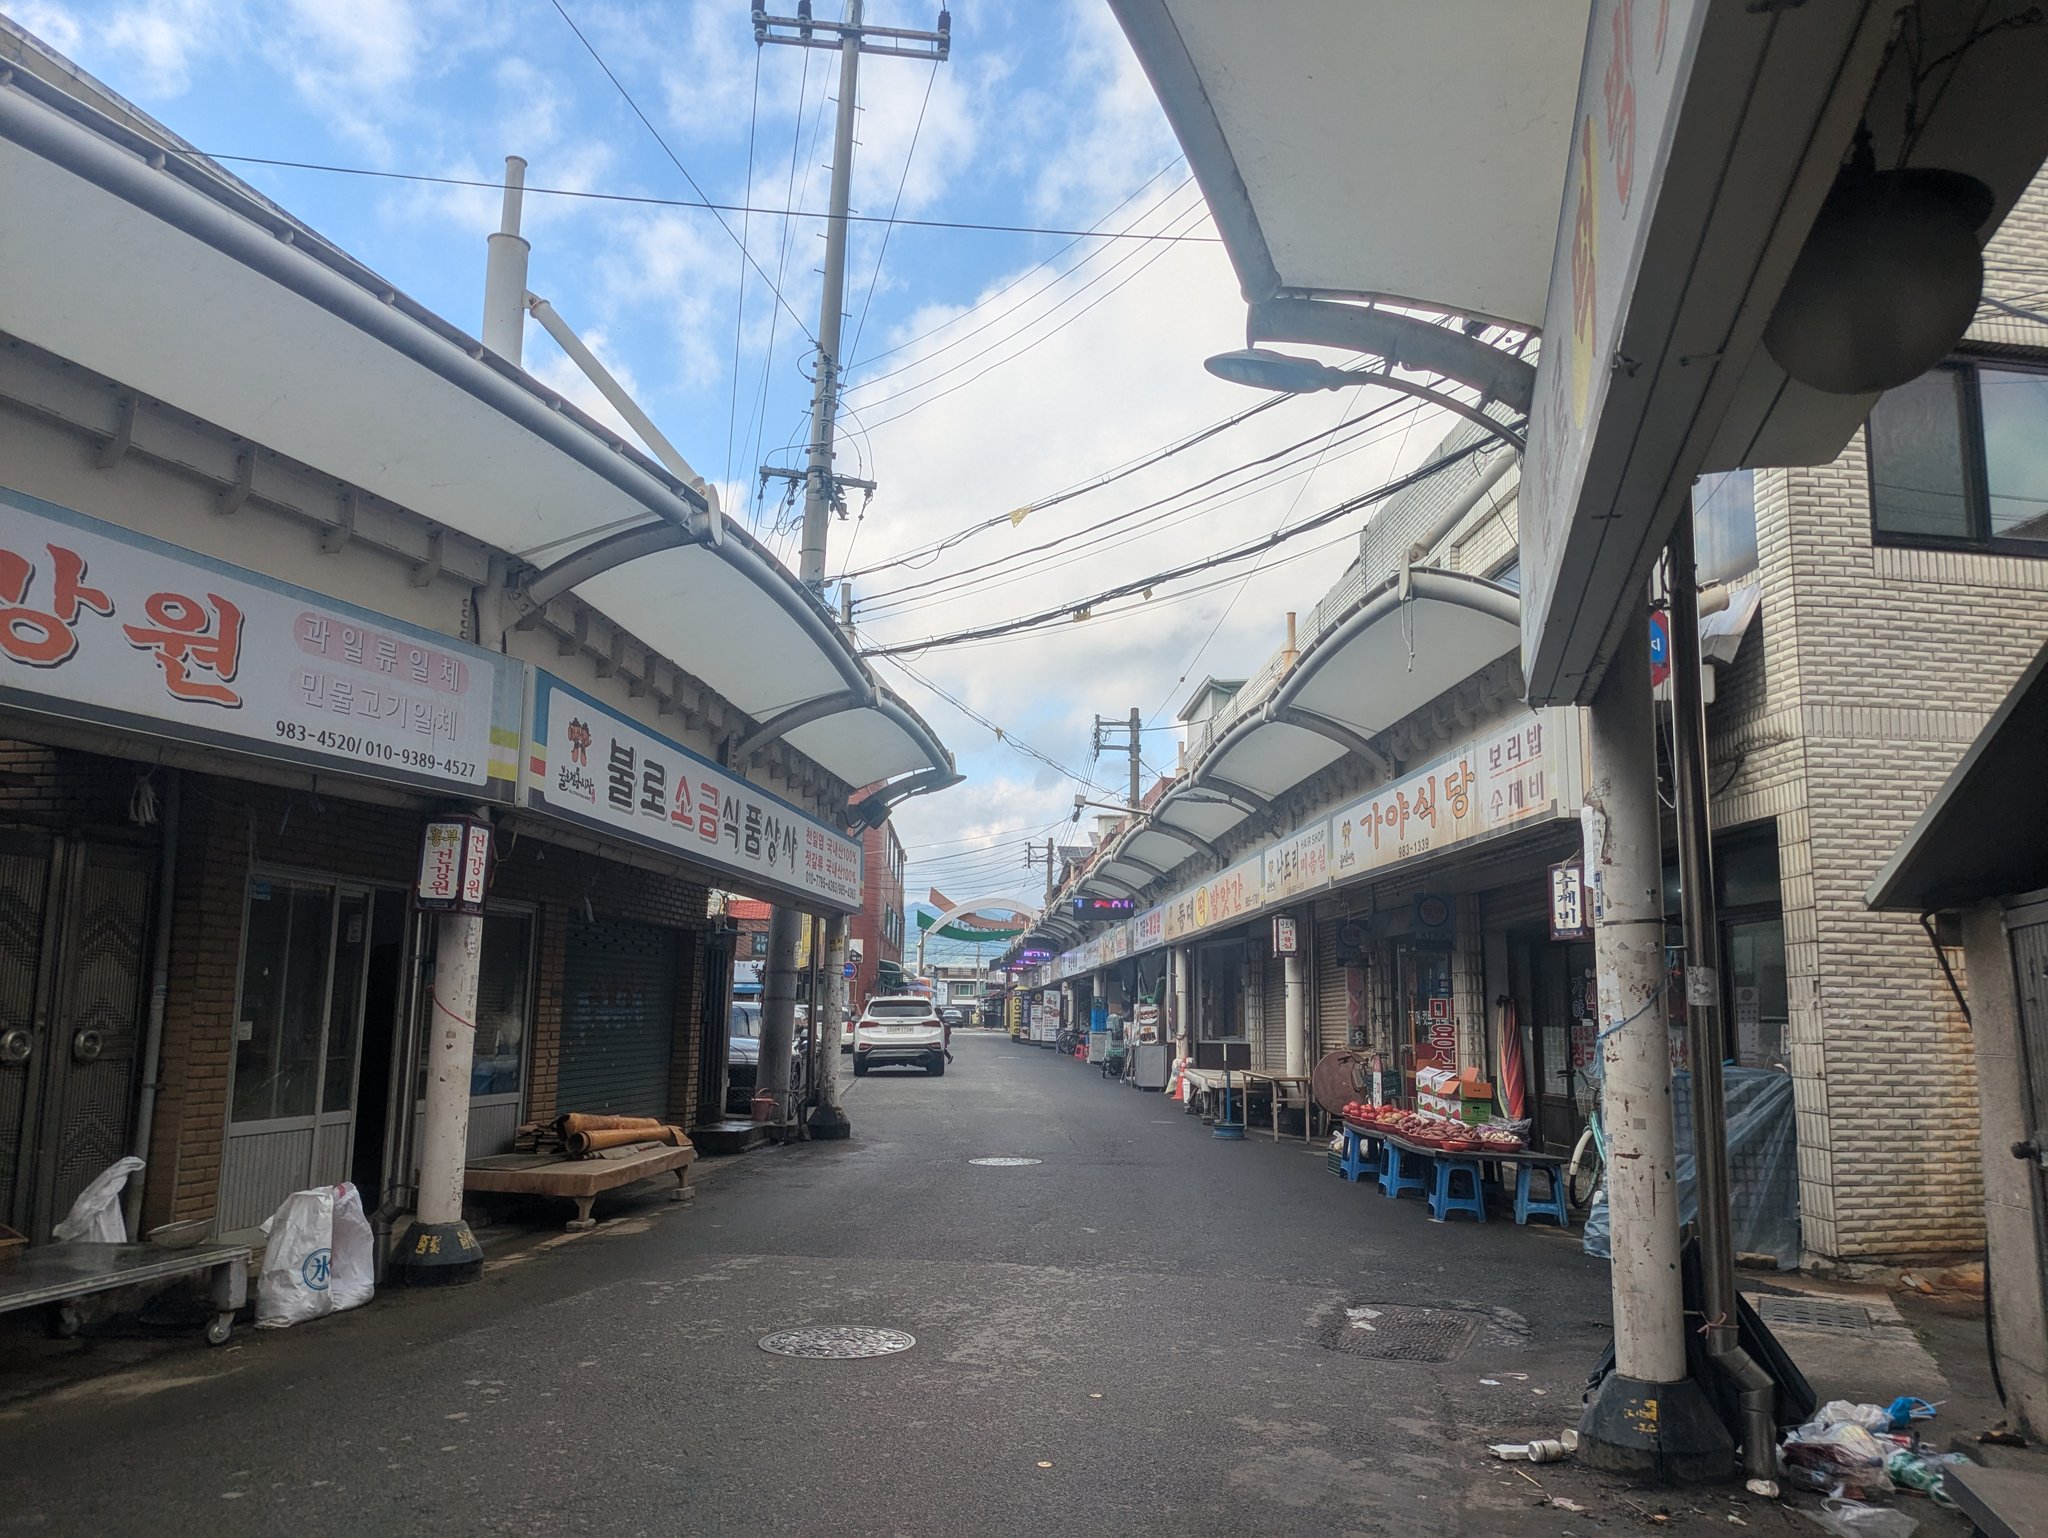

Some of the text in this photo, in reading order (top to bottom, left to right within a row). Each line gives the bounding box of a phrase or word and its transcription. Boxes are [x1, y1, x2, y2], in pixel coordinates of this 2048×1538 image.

[1489, 723, 1543, 770] 보리밥
[607, 737, 798, 874] 불로소금식품상사
[1360, 760, 1475, 849] 가야식당
[1490, 771, 1544, 817] 수제비
[428, 848, 455, 896] 건강원
[467, 834, 485, 899] 건강원
[1300, 844, 1326, 878] 미용실
